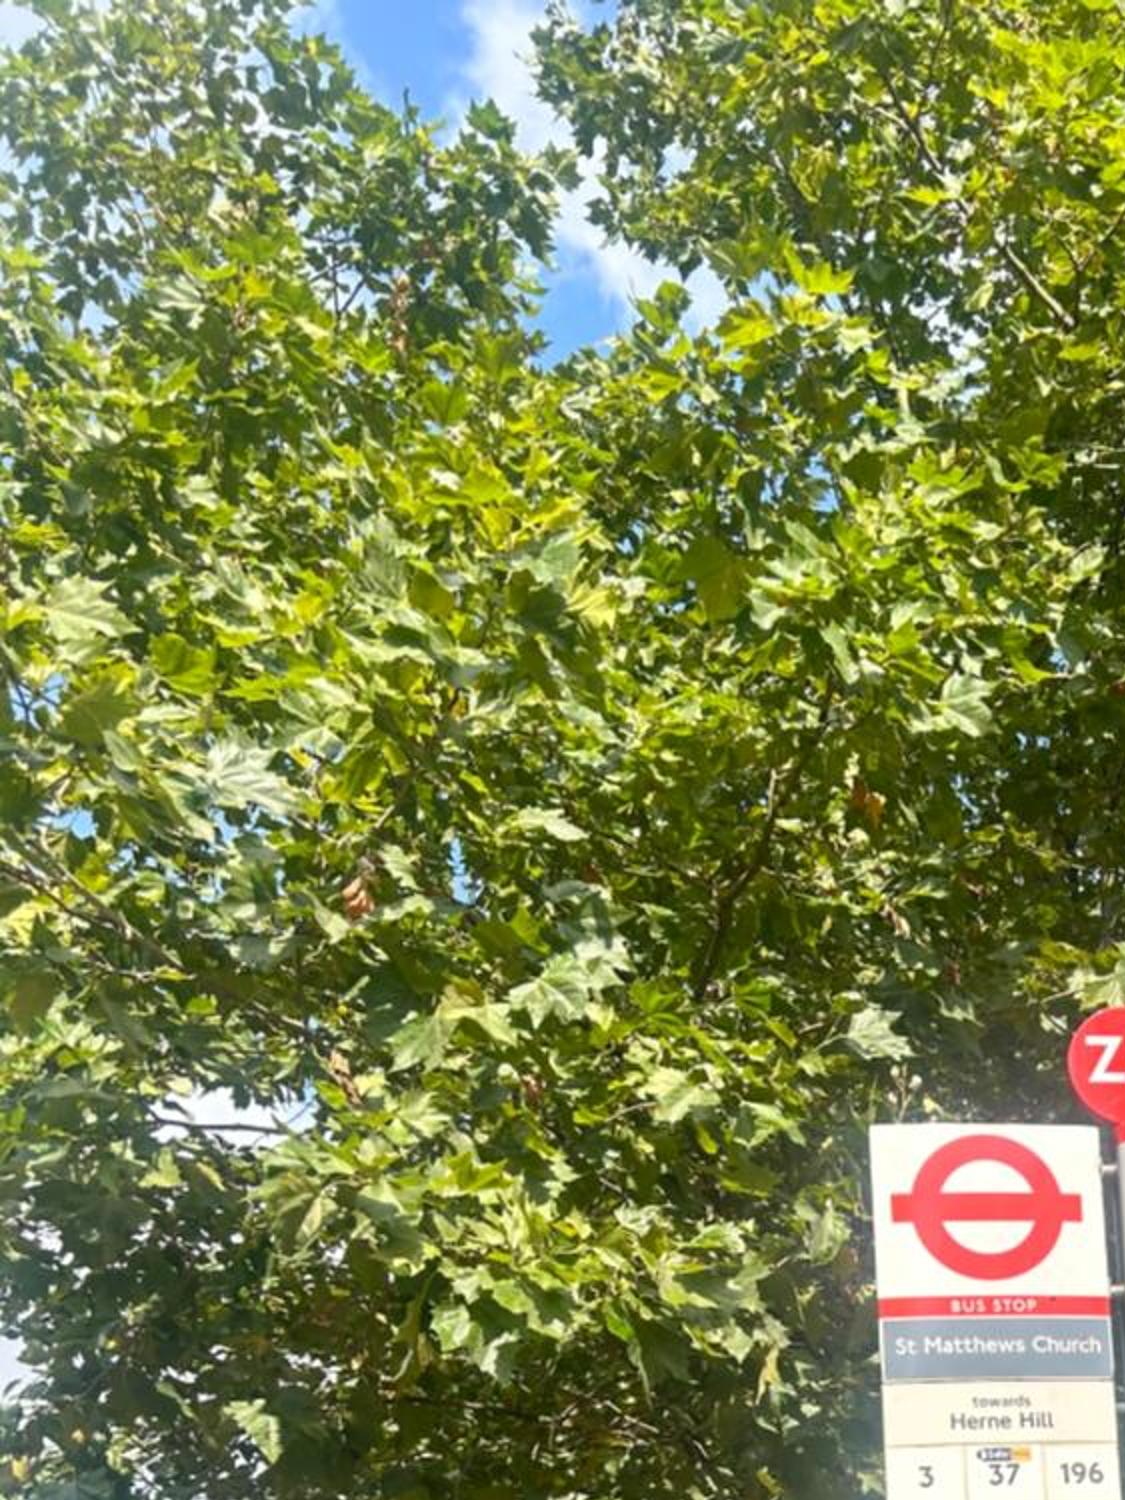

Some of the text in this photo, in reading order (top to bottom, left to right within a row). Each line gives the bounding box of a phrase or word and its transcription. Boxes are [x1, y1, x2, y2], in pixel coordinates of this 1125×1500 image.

[950, 1298, 1037, 1313] BUS STOP
[895, 1335, 1102, 1356] St Matthews Church
[972, 1394, 1031, 1408] towards
[950, 1411, 1054, 1431] Herne Hill
[918, 1466, 935, 1488] 3
[988, 1463, 1020, 1486] 37
[1060, 1462, 1104, 1485] 196
